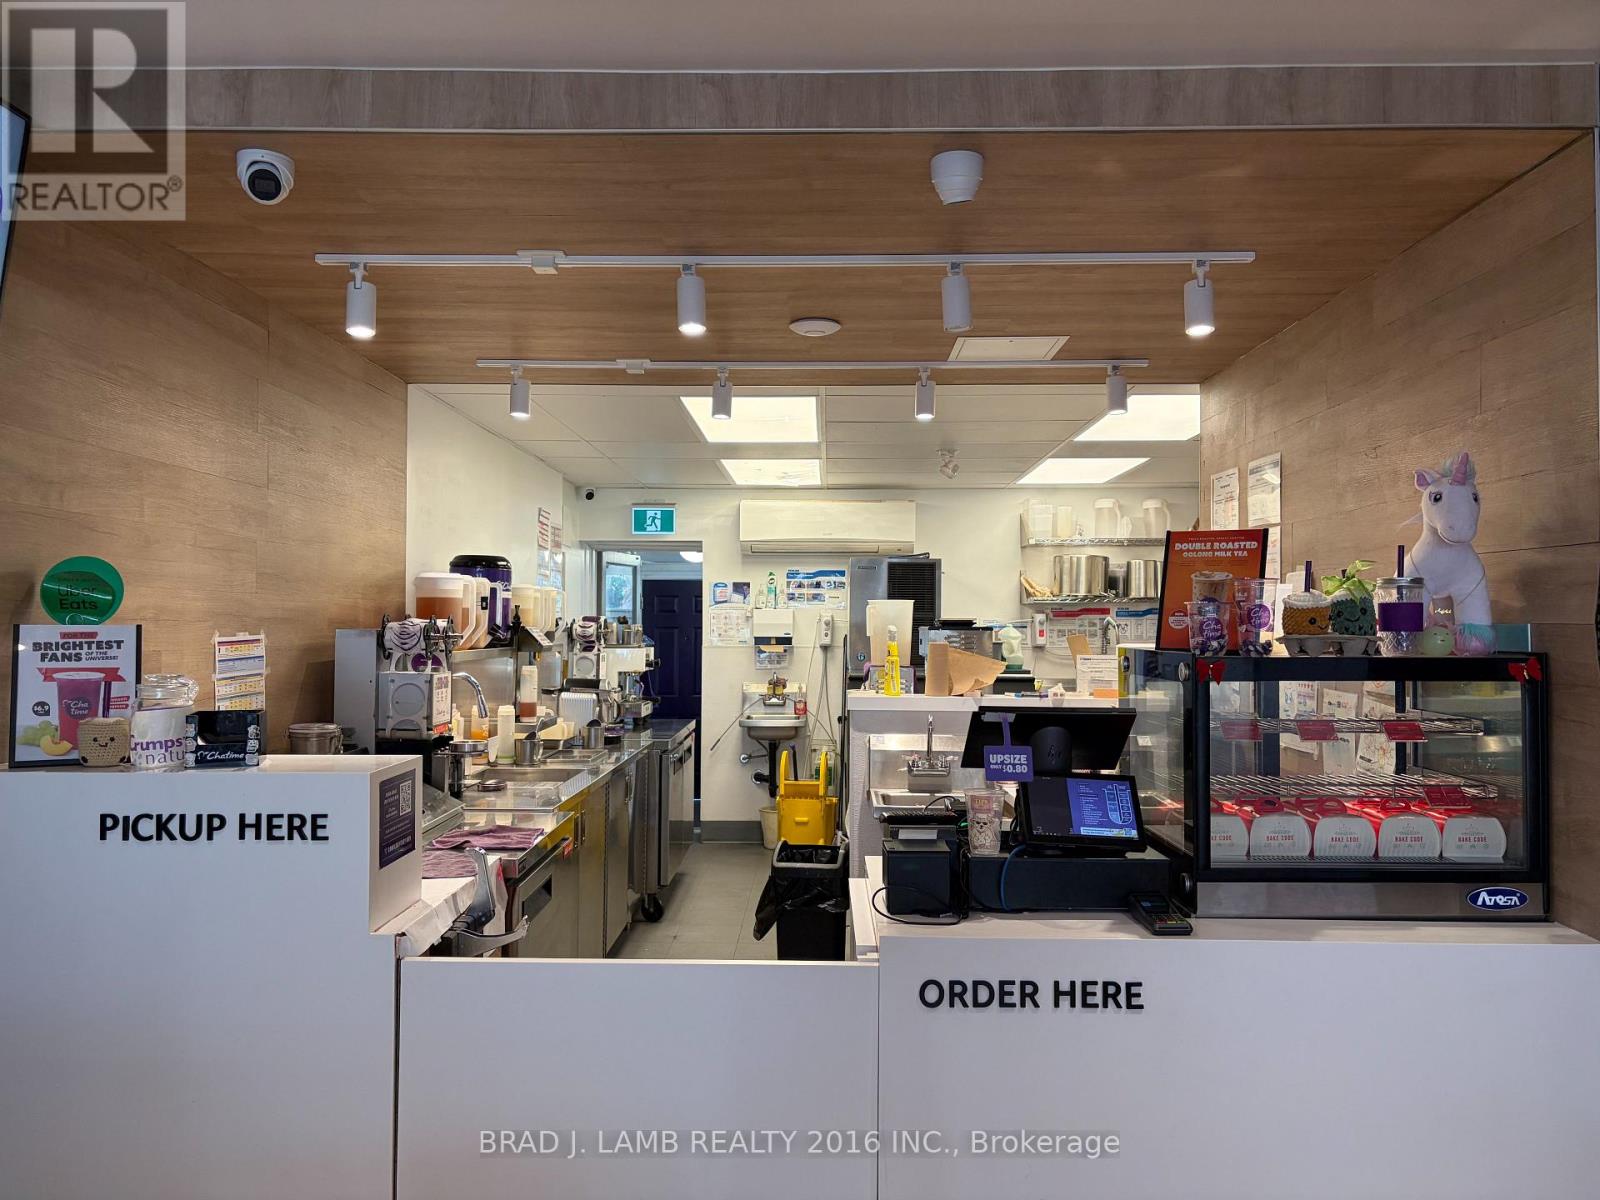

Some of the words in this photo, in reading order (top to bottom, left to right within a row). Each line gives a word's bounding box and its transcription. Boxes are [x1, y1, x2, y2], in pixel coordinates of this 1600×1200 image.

[1213, 541, 1258, 549] ROASTED
[57, 584, 97, 597] Uber
[60, 599, 98, 610] Eats
[32, 640, 124, 651] BRIGHTEST
[40, 652, 82, 662] FANS
[207, 751, 245, 760] Chatime
[990, 754, 1027, 764] UPSIZE
[1003, 764, 1028, 773] $0.80
[99, 813, 227, 842] PICKUP
[238, 813, 329, 841] HERE
[918, 979, 1040, 1009] ORDER
[1053, 980, 1144, 1010] HERE
